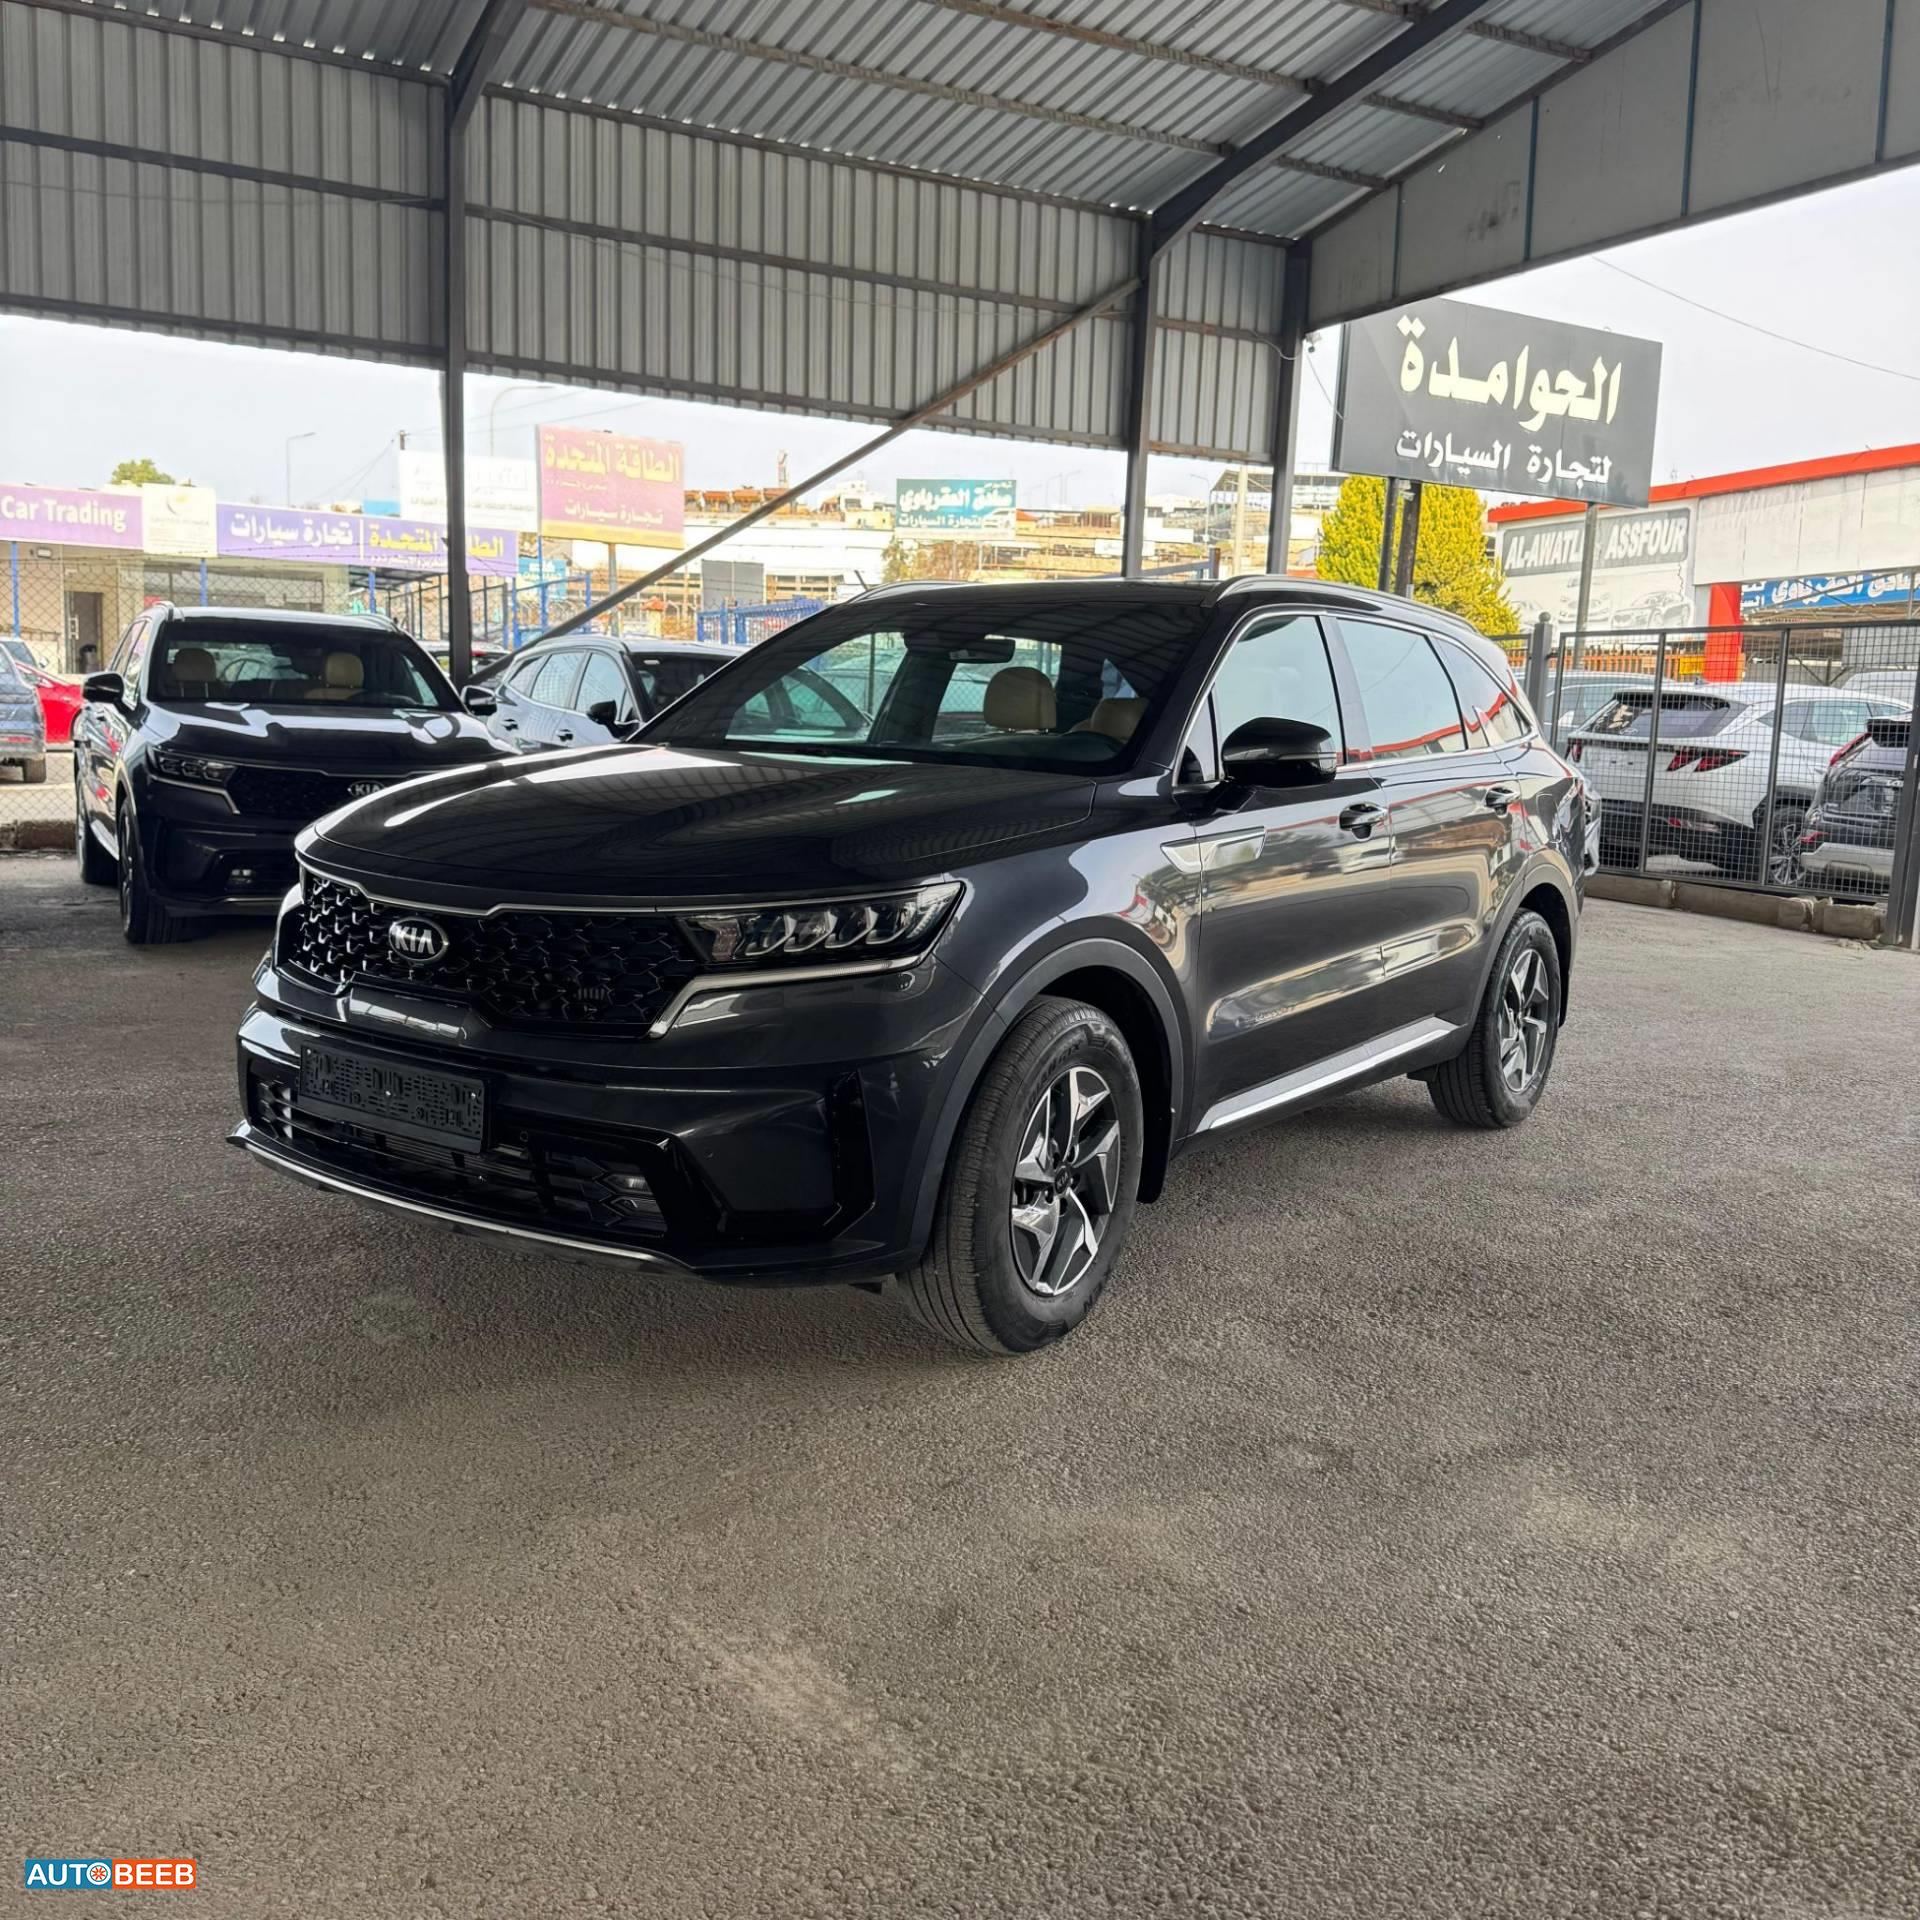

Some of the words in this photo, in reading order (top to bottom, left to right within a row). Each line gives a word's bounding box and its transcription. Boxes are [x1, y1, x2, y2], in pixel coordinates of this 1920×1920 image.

[1397, 315, 1621, 431] الحوامدة
[615, 443, 680, 482] الطاقة
[1396, 430, 1511, 475] السيارات
[1526, 444, 1612, 490] لتجارة
[1, 495, 39, 520] Car
[43, 499, 127, 533] Trading
[230, 512, 298, 545] سيارات
[565, 498, 618, 522] سيارات
[620, 504, 664, 528] تجارة
[303, 519, 354, 549] تجارة
[1504, 528, 1585, 571] AL-AWATL
[1604, 516, 1689, 561] ASSFOUR
[394, 924, 436, 955] KIA
